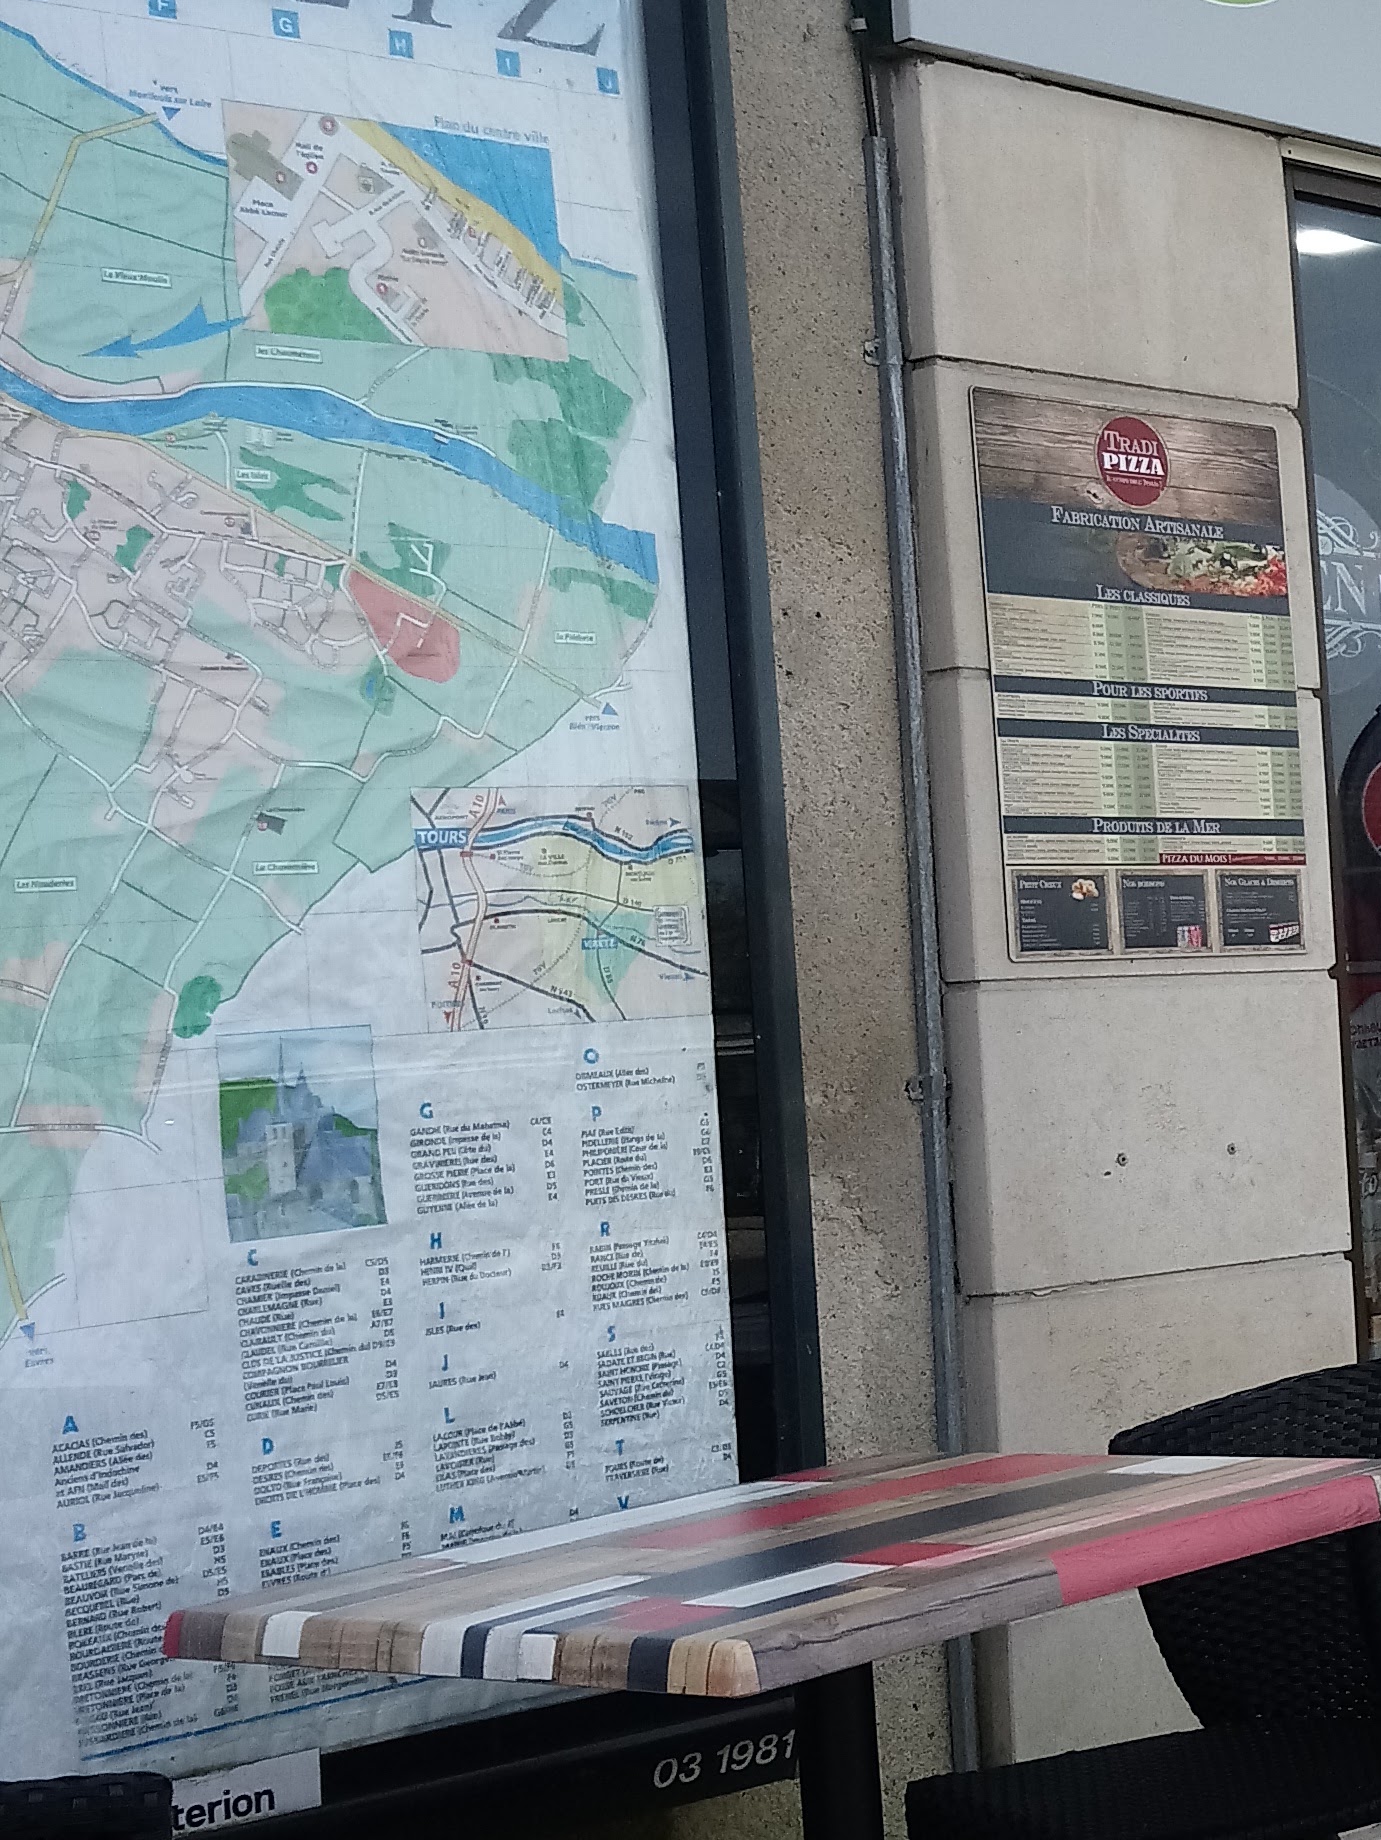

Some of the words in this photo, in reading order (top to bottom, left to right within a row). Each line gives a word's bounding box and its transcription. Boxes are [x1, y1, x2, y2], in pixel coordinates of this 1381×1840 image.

[1104, 430, 1158, 457] TRADI
[1102, 452, 1165, 476] PIZZA
[1051, 505, 1140, 531] FABRICATION
[1144, 515, 1224, 539] ARTISANALE
[1097, 584, 1122, 601] LES
[1124, 591, 1191, 607] CLASSIQUES
[1092, 681, 1127, 697] POUR
[1131, 686, 1152, 699] LES
[1155, 688, 1208, 701] SPORTIFS
[1101, 724, 1126, 739] LES
[1092, 818, 1154, 833] PRODUITS
[1156, 821, 1173, 833] DE
[1174, 821, 1190, 833] LA
[1193, 819, 1220, 834] MER
[418, 831, 468, 844] TOURS
[1162, 854, 1189, 864] PIZZA
[1190, 854, 1203, 863] DU
[1204, 854, 1227, 863] MOIS
[653, 1753, 703, 1789] 03
[716, 1729, 797, 1775] 1981
